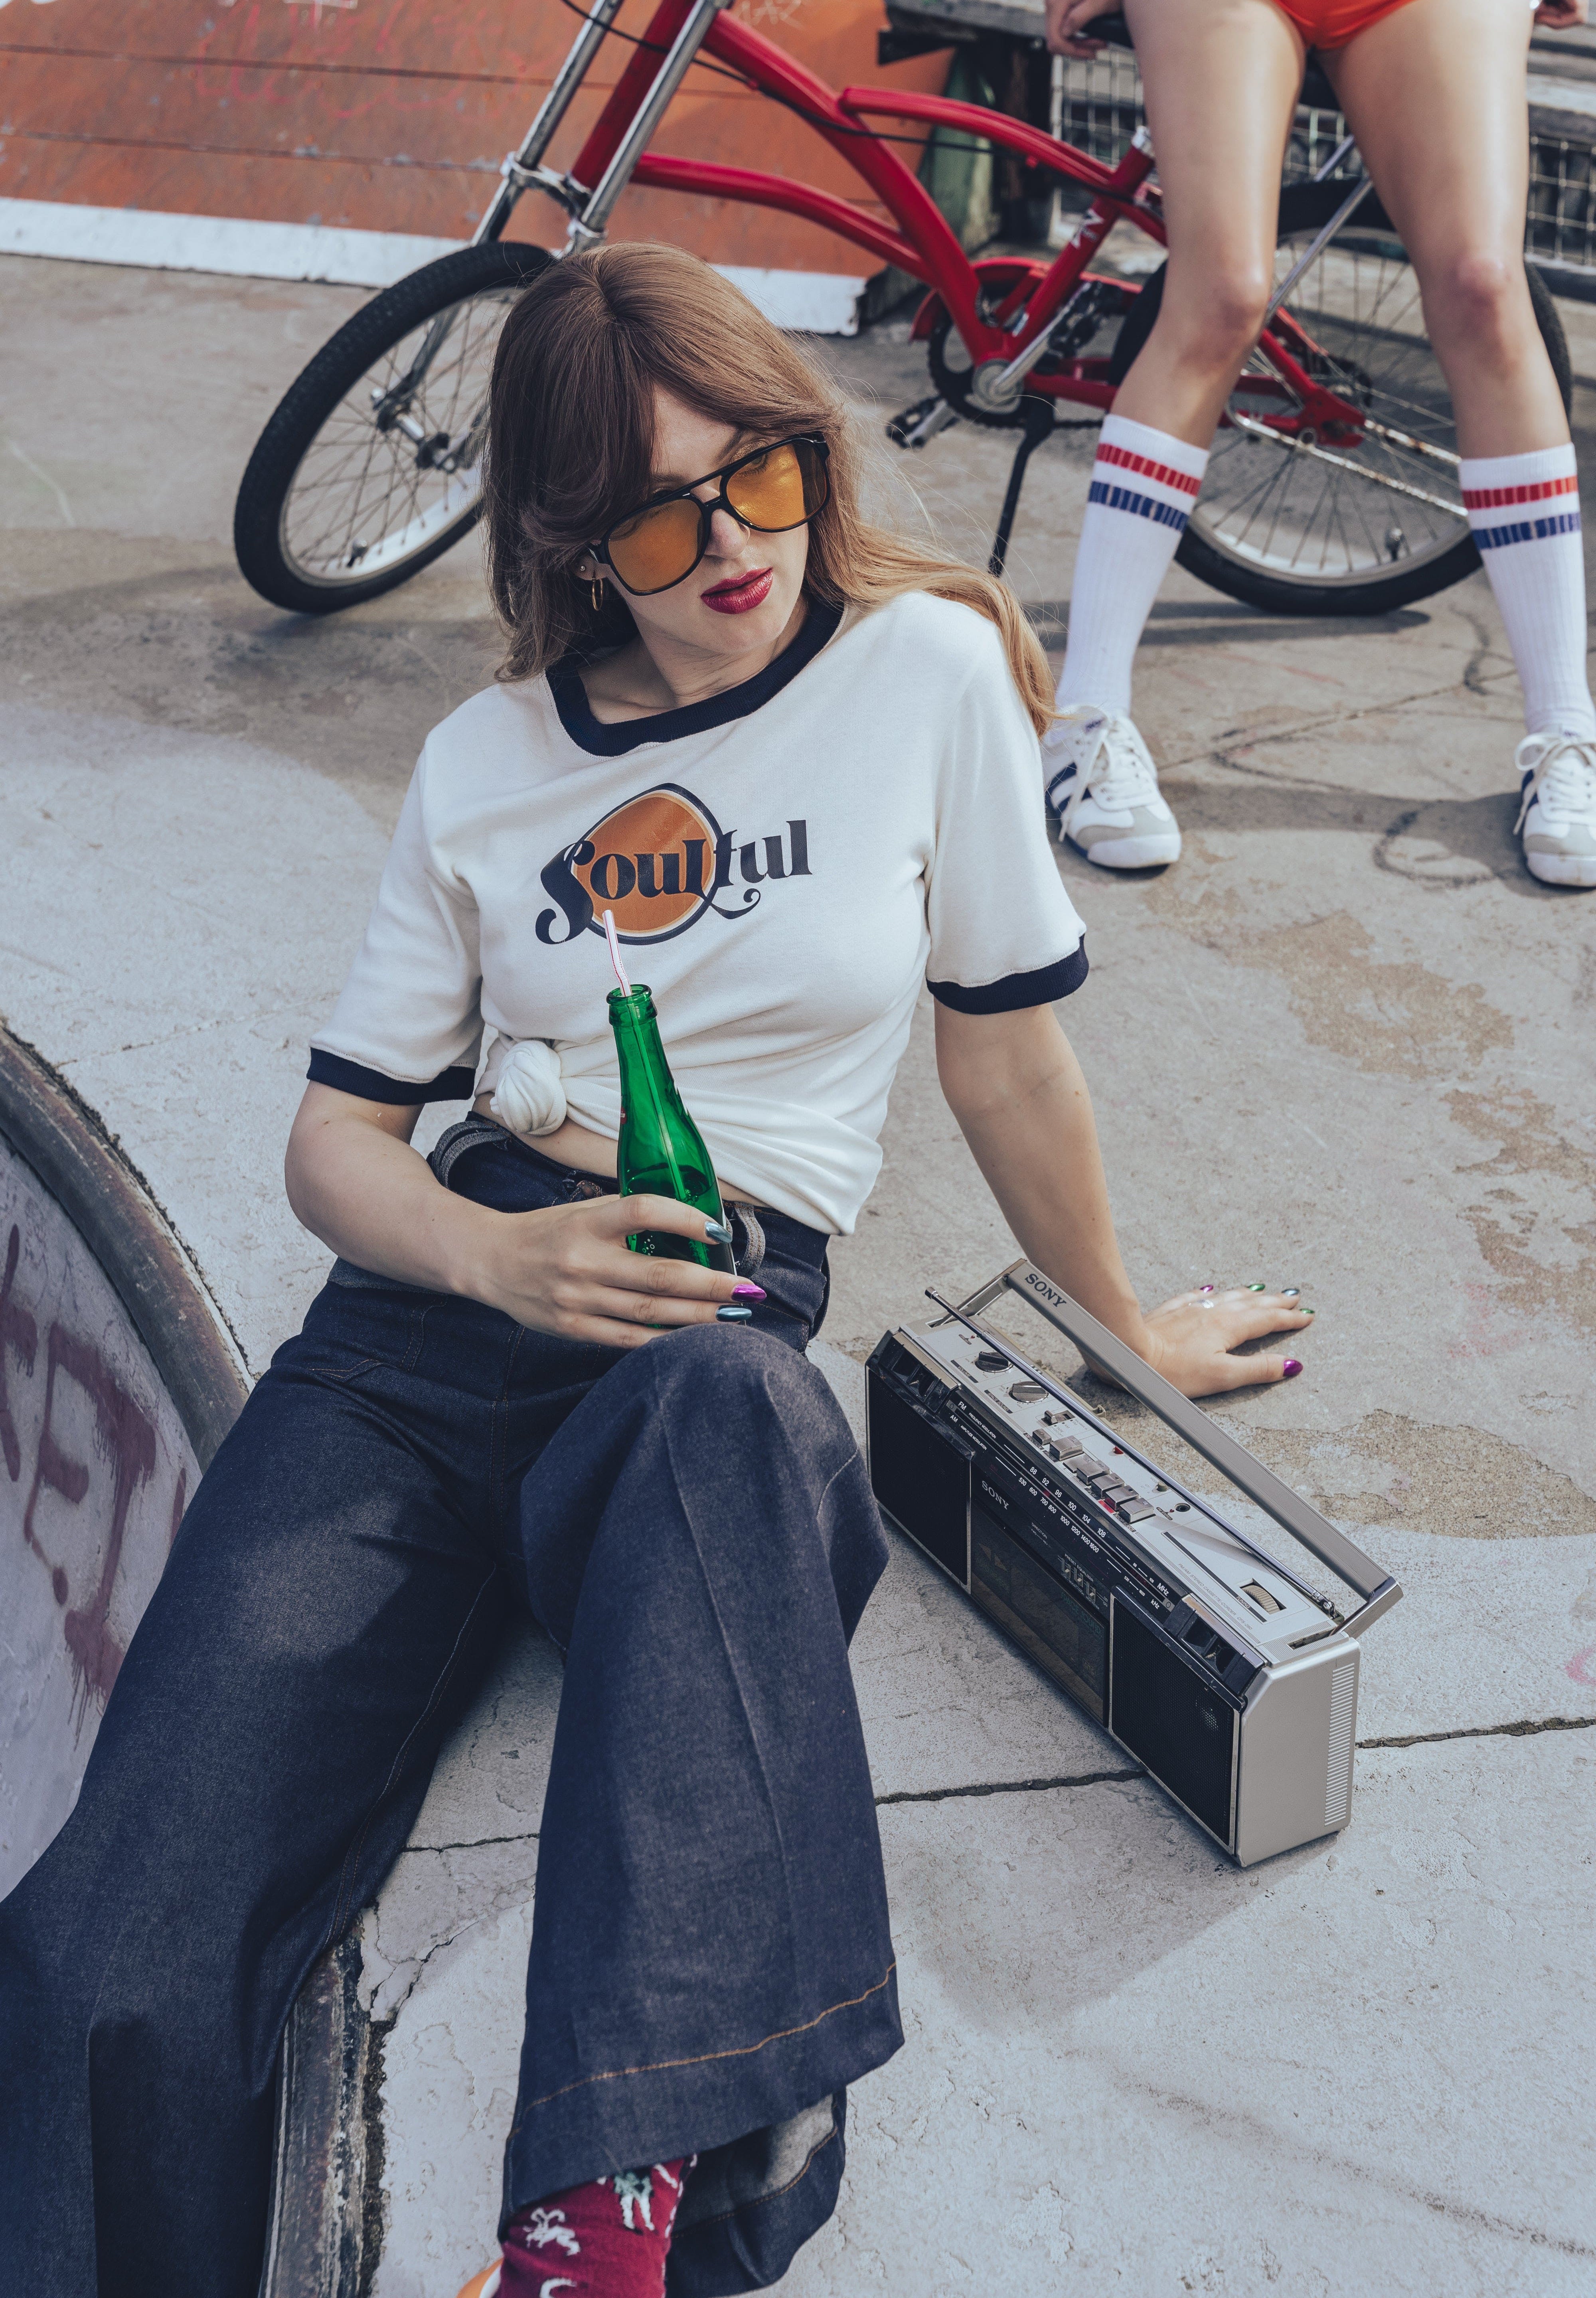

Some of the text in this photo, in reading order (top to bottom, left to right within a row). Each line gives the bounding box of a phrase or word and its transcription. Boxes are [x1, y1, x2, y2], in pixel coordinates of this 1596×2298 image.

[535, 819, 813, 945] Soulful
[1025, 1273, 1067, 1307] SONY
[958, 1366, 972, 1378] VOLUME
[987, 1392, 1009, 1411] SPACE SOUND
[958, 1401, 996, 1439] FM FREQUENCY MODULATION
[960, 1425, 973, 1437] AMPLITUDE
[972, 1436, 987, 1450] MODULATION
[1025, 1434, 1043, 1449] DIRECTION
[982, 1481, 1009, 1510] SONY
[1087, 1489, 1098, 1498] PLAY
[1018, 1477, 1027, 1486] 530
[1029, 1487, 1037, 1496] 600
[1048, 1504, 1057, 1514] 800
[1060, 1516, 1070, 1526] 1000
[1071, 1526, 1080, 1536] 1200
[1080, 1534, 1090, 1545] 1400
[1089, 1542, 1099, 1553] 1600
[1042, 1478, 1049, 1486] 92
[1055, 1489, 1062, 1498] 96
[1068, 1501, 1077, 1510] 100
[1082, 1514, 1091, 1524] 104
[1097, 1528, 1106, 1538] 108
[1032, 1522, 1047, 1539] DIRECTION
[1065, 1553, 1094, 1582] PRESET EQUALIZER
[1157, 1583, 1169, 1596] MHz
[1178, 1563, 1191, 1574] FM/AM
[1190, 1574, 1204, 1587] STEREO
[1203, 1586, 1237, 1615] CASSETTE-CORDER
[1151, 1599, 1160, 1609] kHz
[1236, 1596, 1251, 1609] TUNING
